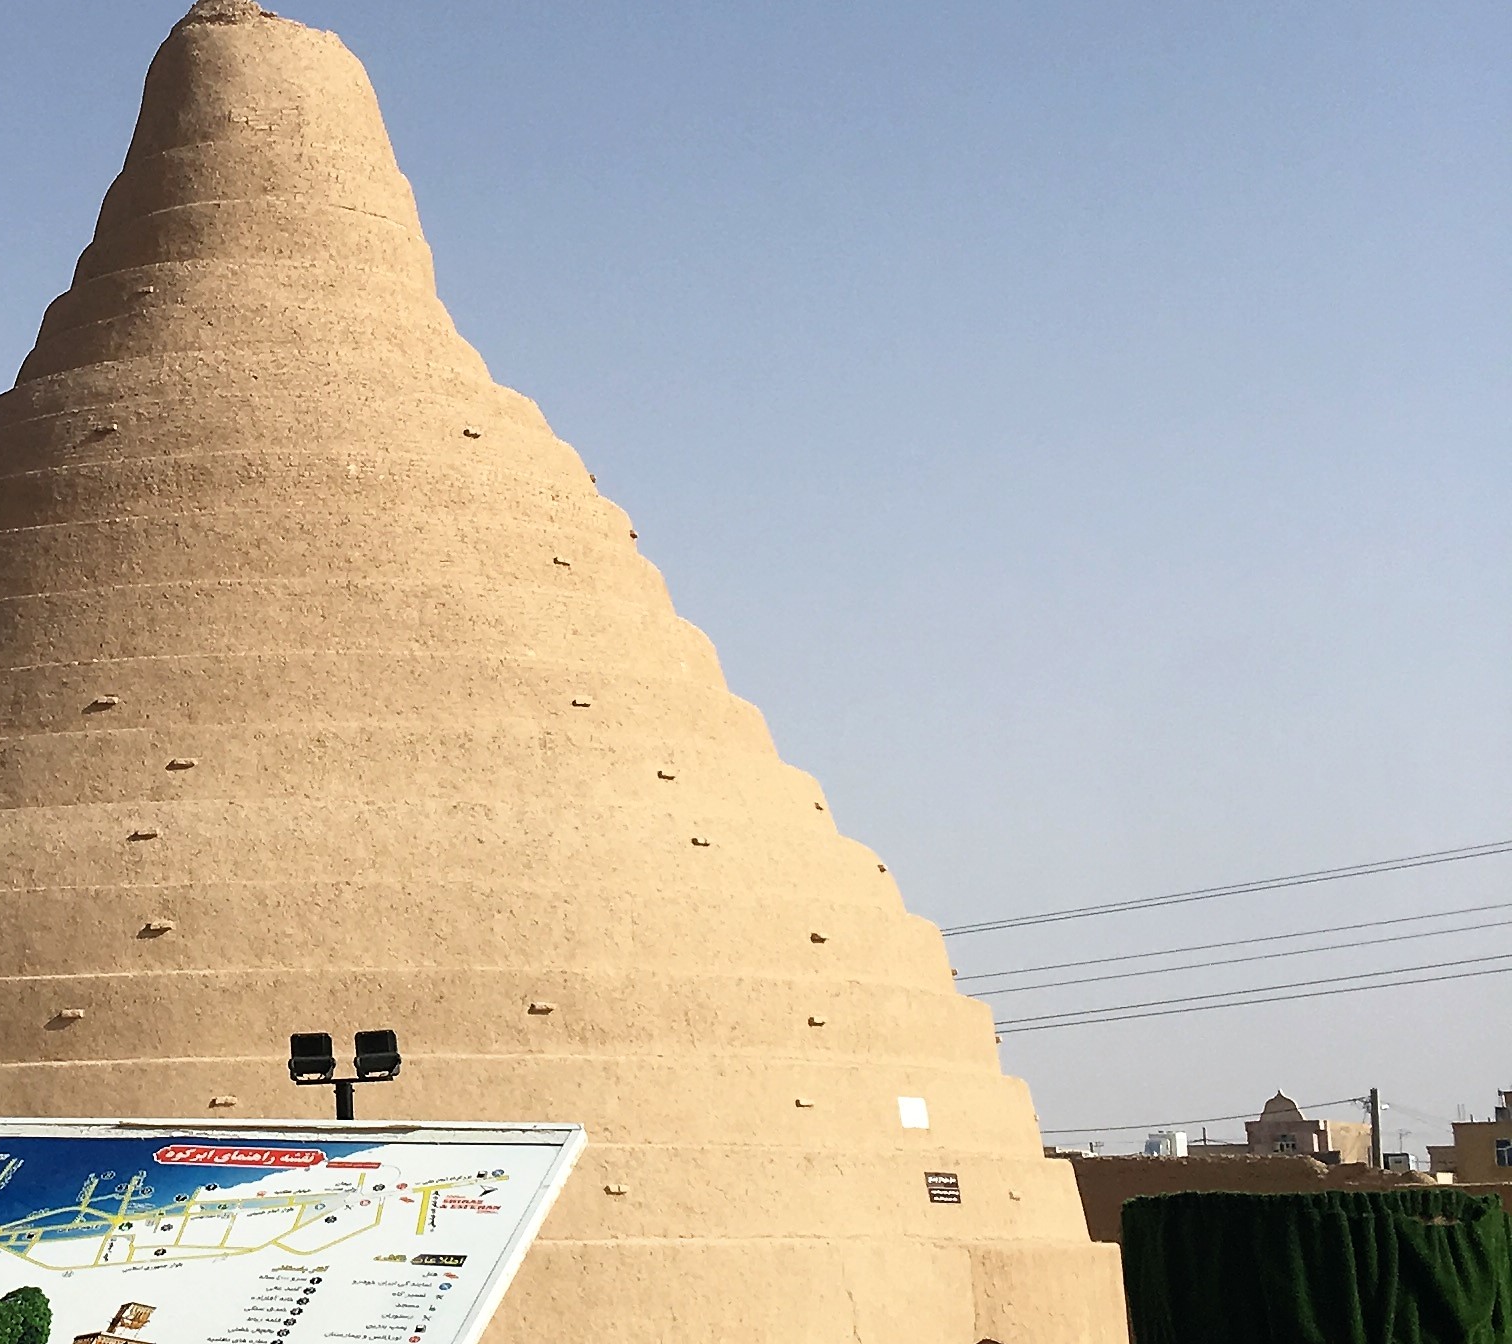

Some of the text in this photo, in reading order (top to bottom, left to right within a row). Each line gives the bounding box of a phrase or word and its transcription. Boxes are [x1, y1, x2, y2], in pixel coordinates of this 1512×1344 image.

[165, 1148, 316, 1164] نقشه راهنمای ابرکوه
